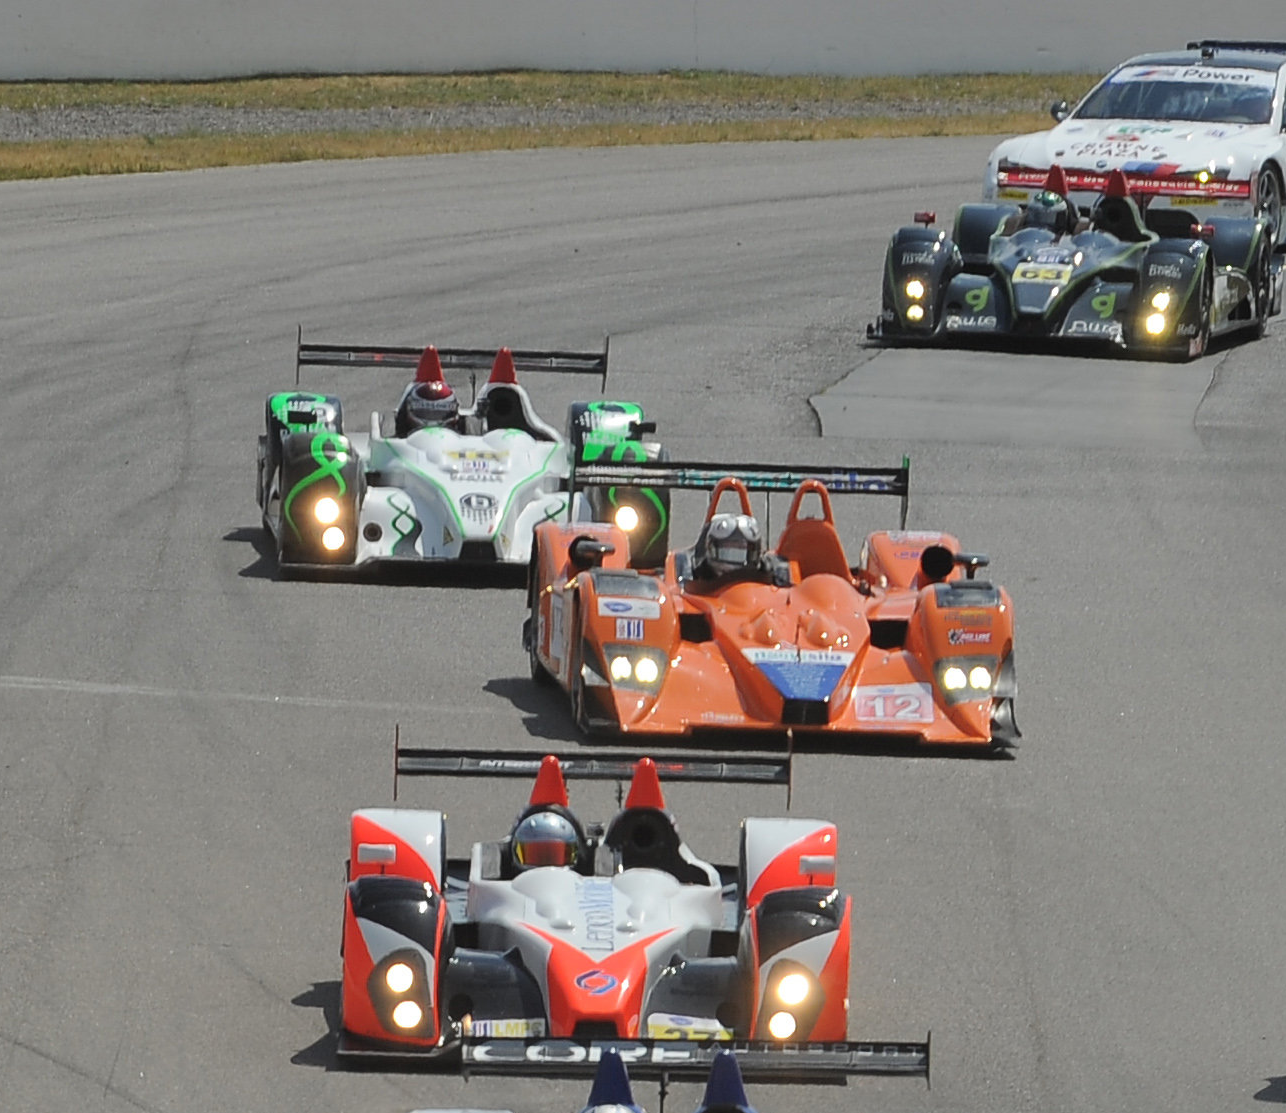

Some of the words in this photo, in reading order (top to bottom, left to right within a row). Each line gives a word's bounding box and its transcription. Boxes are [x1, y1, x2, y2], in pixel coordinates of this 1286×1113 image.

[1182, 68, 1255, 82] Power
[868, 695, 923, 719] 12
[473, 1040, 693, 1063] CORE
